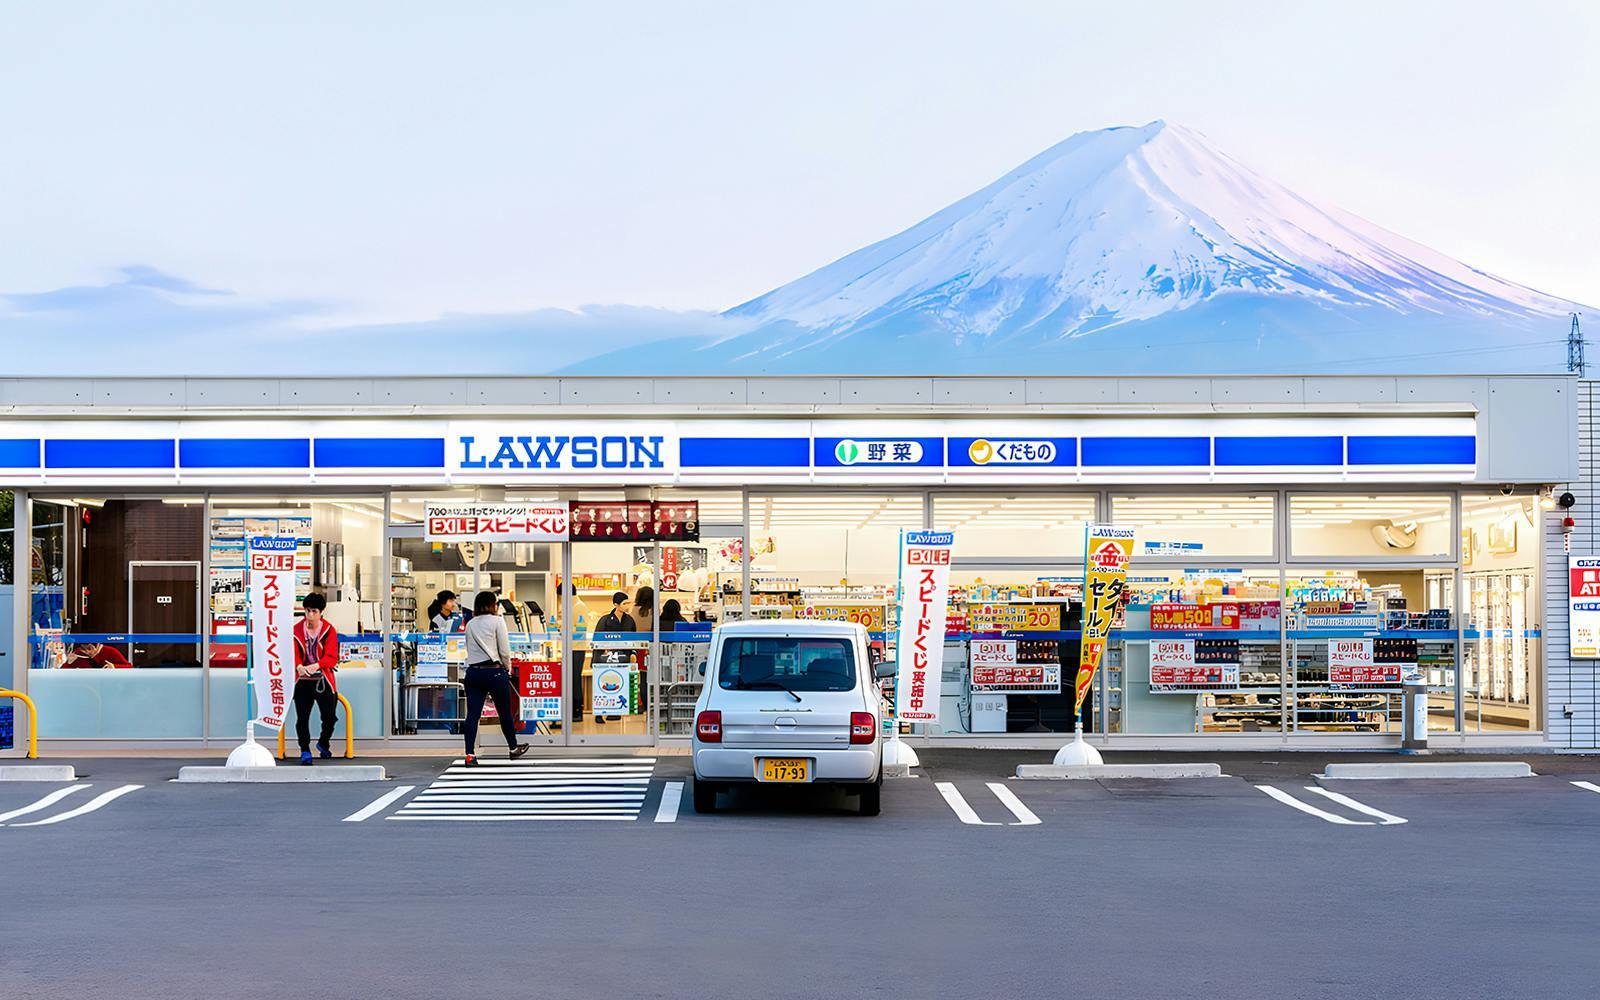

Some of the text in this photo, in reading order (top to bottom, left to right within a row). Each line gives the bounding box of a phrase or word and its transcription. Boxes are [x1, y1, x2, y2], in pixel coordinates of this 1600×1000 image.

[459, 436, 664, 468] LAWSON
[867, 443, 912, 461] 野菜
[996, 443, 1051, 460] くだもの
[430, 517, 567, 535] EXILE スピードくじ
[1092, 528, 1134, 537] LAWSON
[252, 540, 295, 549] LAWSON
[908, 534, 951, 543] LAWSON
[252, 554, 294, 571] EXILE
[908, 549, 950, 565] EXILE
[1099, 543, 1121, 567] 金
[1028, 612, 1050, 627] 20
